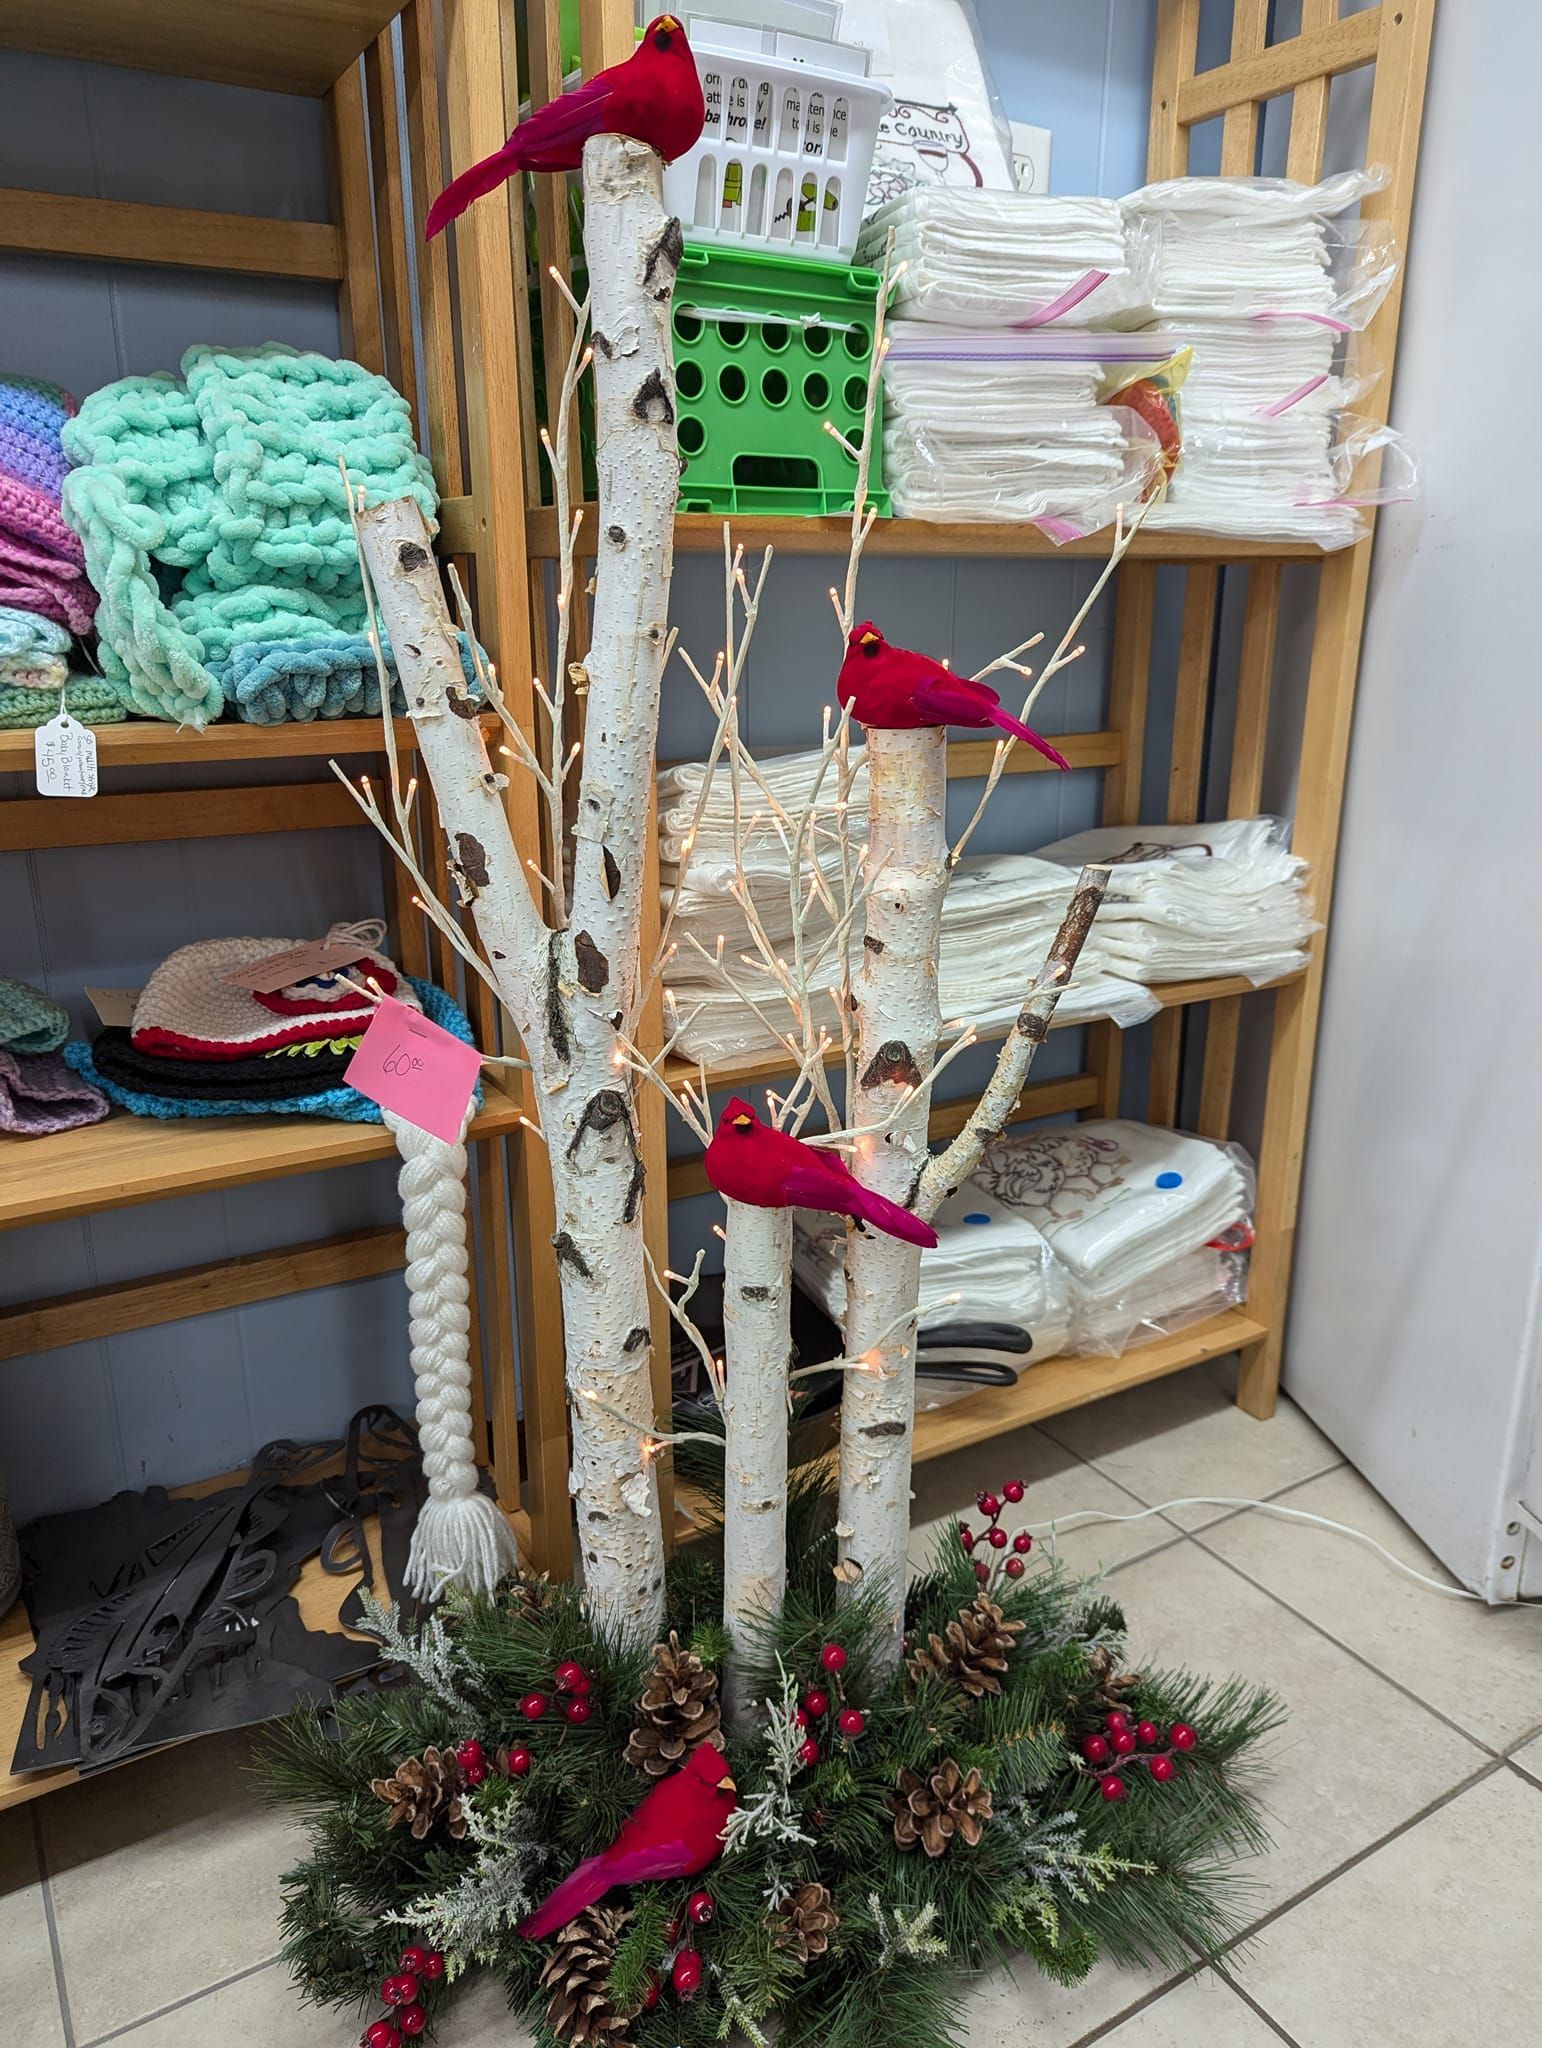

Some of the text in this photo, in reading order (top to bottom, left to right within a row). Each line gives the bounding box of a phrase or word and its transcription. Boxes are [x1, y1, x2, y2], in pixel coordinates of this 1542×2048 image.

[736, 94, 746, 108] is
[704, 109, 767, 130] bahroe!
[812, 120, 821, 134] is
[61, 756, 73, 792] Blanket
